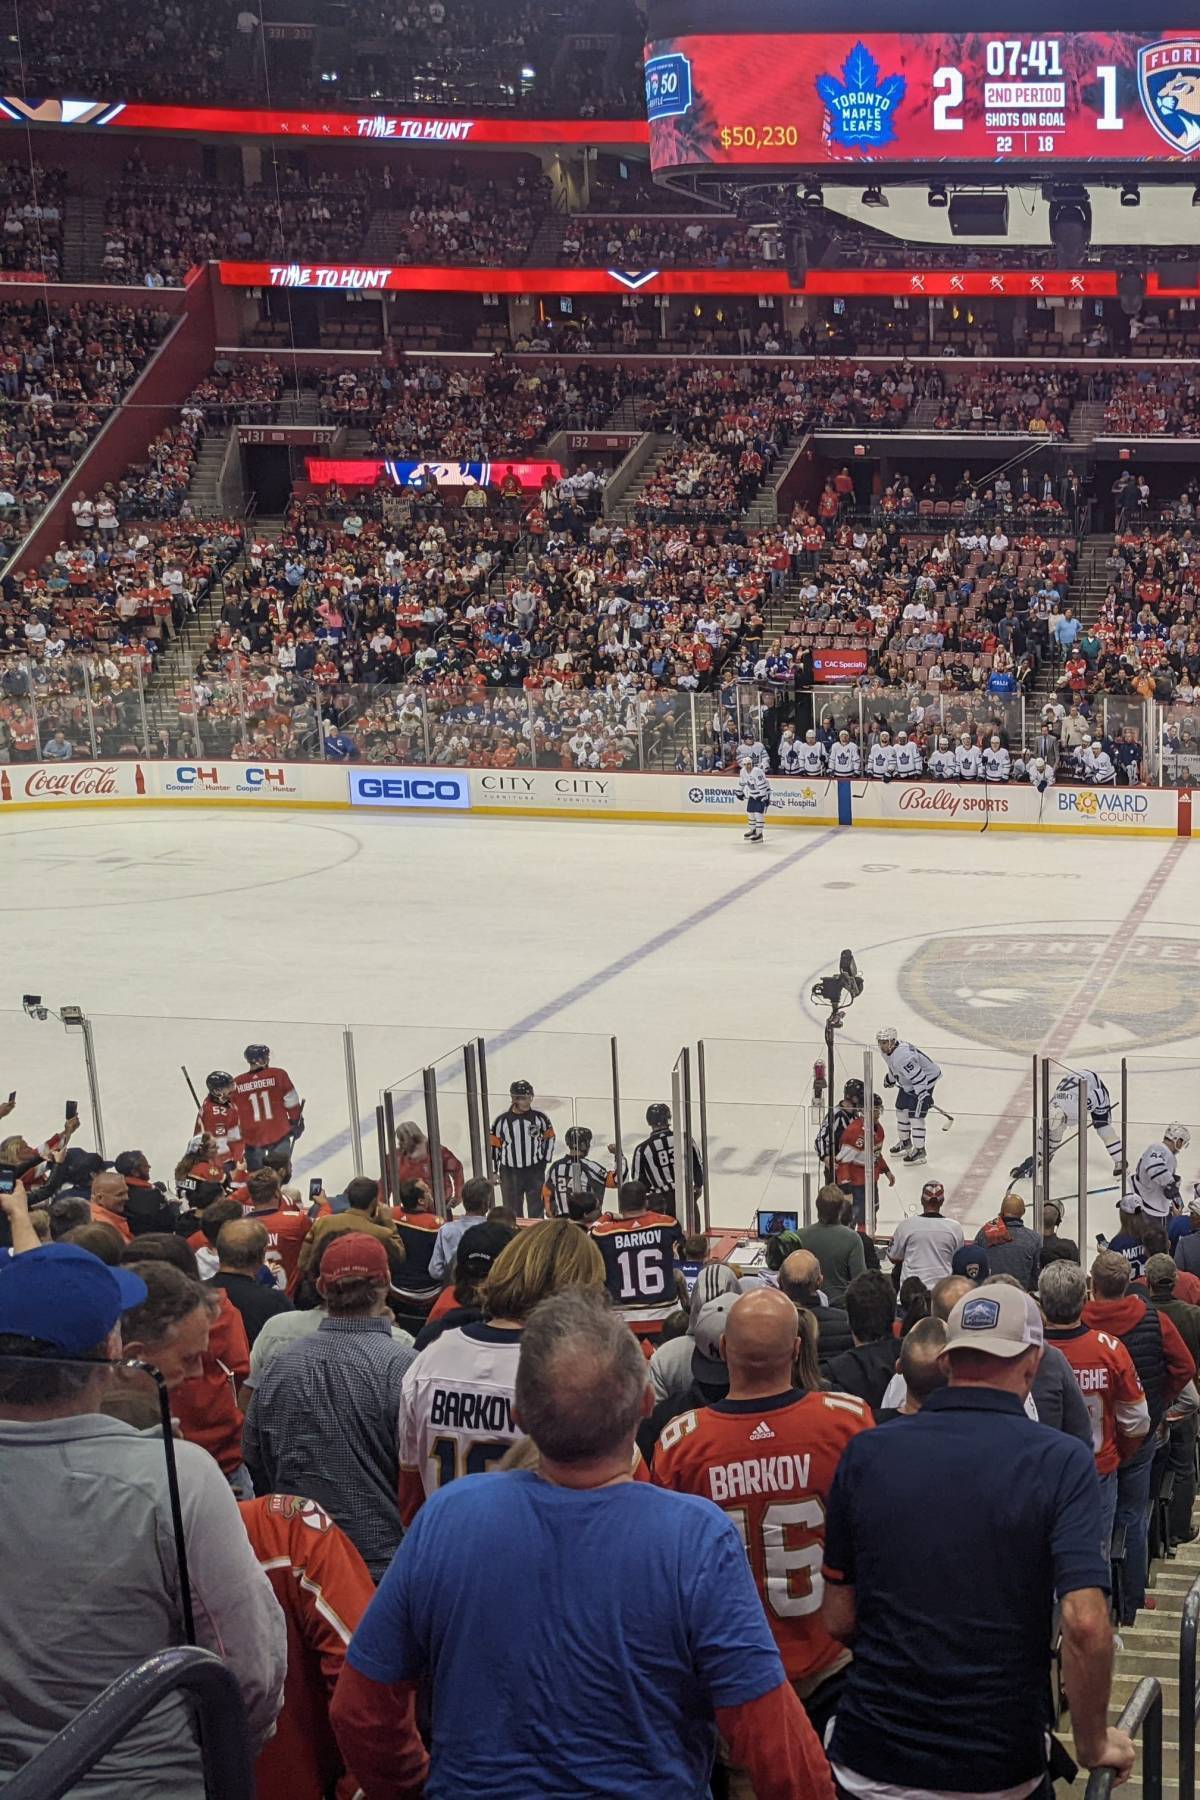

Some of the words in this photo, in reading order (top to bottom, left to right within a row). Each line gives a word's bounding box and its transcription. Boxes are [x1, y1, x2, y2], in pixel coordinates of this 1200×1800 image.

[986, 40, 1062, 76] 07:41
[660, 72, 677, 94] 50
[832, 92, 890, 111] TORONTO
[933, 67, 963, 130] 2
[988, 88, 1012, 103] 2ND
[1015, 87, 1062, 103] PERIOD
[1096, 66, 1124, 130] 1
[842, 108, 881, 120] MAPLE
[985, 112, 1020, 126] SHOTS
[1022, 112, 1037, 126] ON
[1039, 112, 1066, 126] GOAL
[357, 116, 397, 138] TIME
[400, 121, 422, 138] TO
[423, 122, 474, 140] HUNT
[842, 120, 882, 132] LEAFS
[720, 126, 798, 149] $50,230
[996, 136, 1012, 152] 22
[1038, 136, 1054, 152] 18
[270, 265, 311, 286] TIME
[315, 269, 338, 287] TO
[340, 270, 392, 288] HUNT
[248, 430, 264, 442] 131
[312, 431, 332, 444] 132
[572, 436, 588, 448] 132
[824, 660, 838, 668] CAC
[840, 660, 866, 669] Specialty
[25, 766, 118, 796] Coca-Cola
[176, 766, 218, 784] CH
[246, 768, 284, 785] CH
[482, 776, 536, 790] CITY
[166, 784, 193, 792] Cooper
[205, 784, 230, 792] Hunter
[236, 784, 261, 792] Cooper
[358, 778, 460, 800] GEICO
[554, 779, 609, 794] CITY
[704, 788, 738, 796] BROWAR
[704, 796, 735, 804] HEALTH
[788, 798, 816, 808] Hospital
[899, 787, 960, 816] Bally
[962, 798, 1008, 812] SPORTS
[1058, 792, 1148, 813] BROWARD
[1100, 812, 1148, 822] COUNTY
[212, 1106, 228, 1116] 52
[248, 1090, 273, 1122] 11
[614, 1230, 662, 1249] BARKOV
[617, 1249, 665, 1298] 16
[749, 1430, 775, 1442] adidas
[708, 1454, 812, 1501] BARKOV
